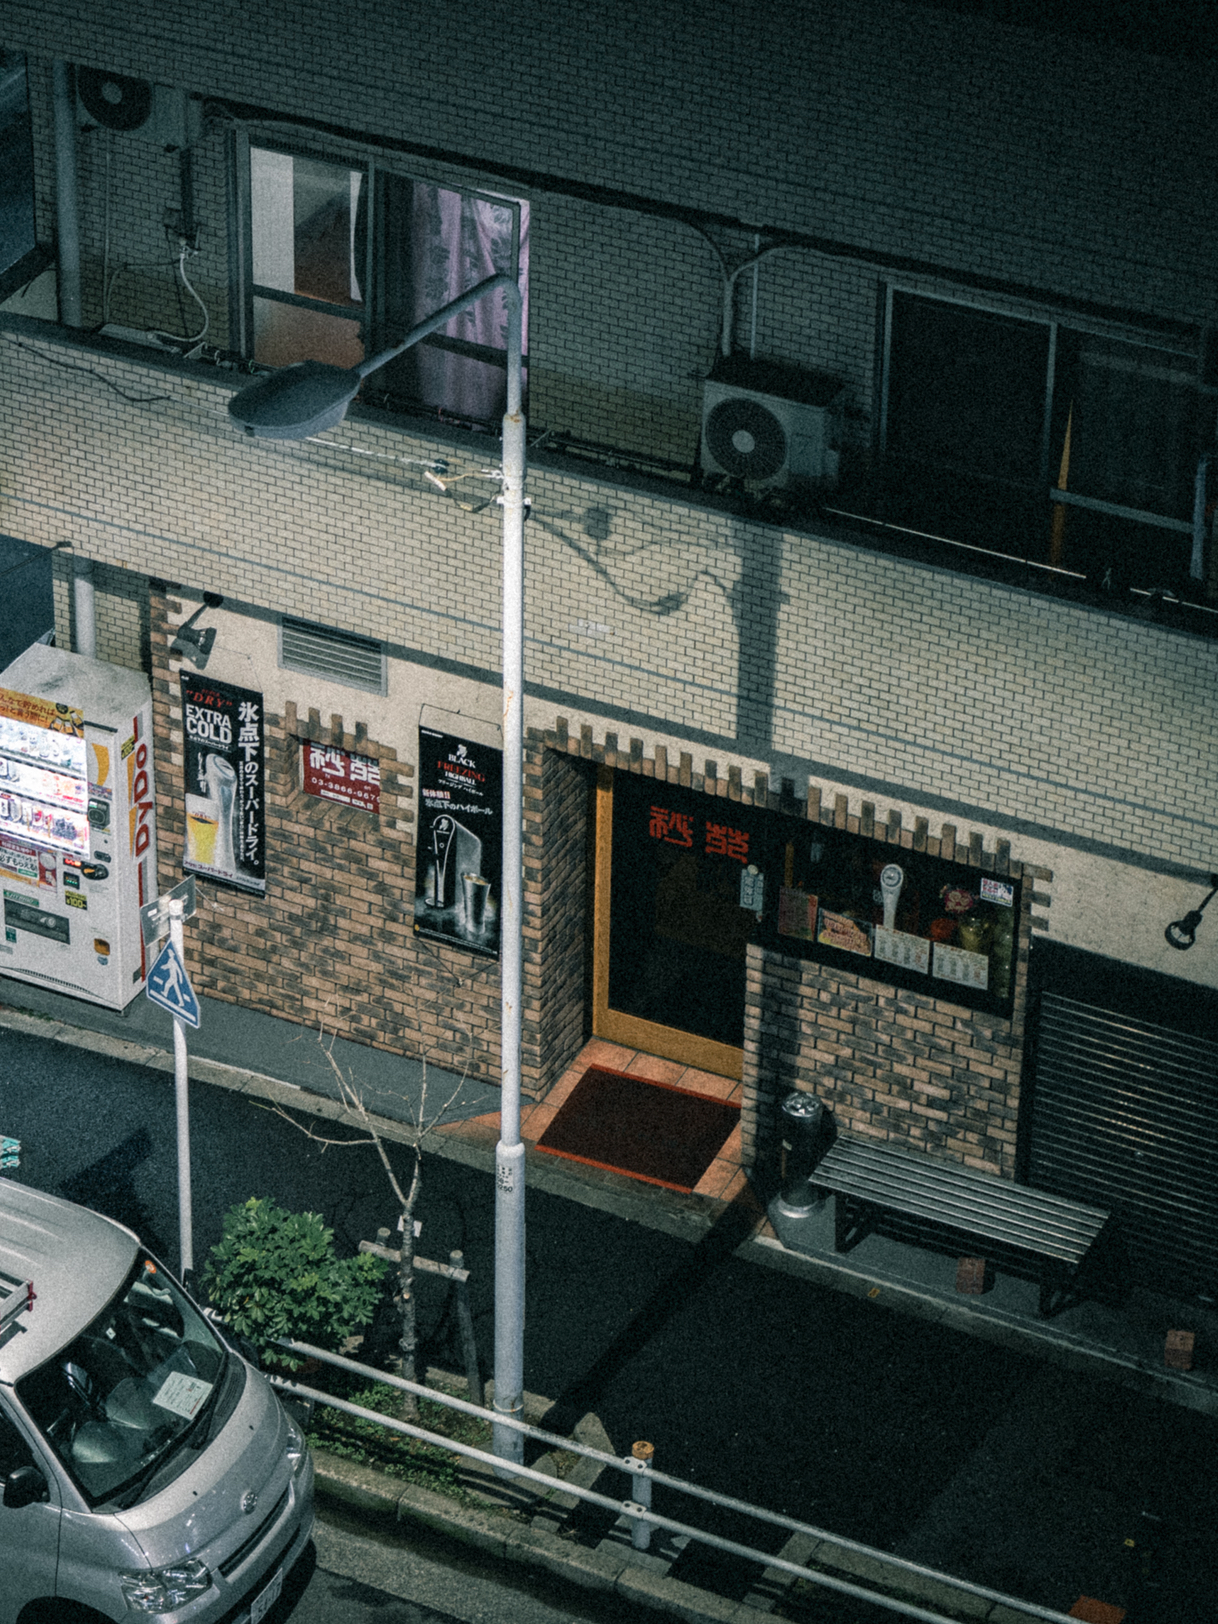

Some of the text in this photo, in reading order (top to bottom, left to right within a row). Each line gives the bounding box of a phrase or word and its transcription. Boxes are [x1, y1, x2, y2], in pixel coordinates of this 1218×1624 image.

[185, 703, 232, 730] EXTRA
[186, 716, 232, 744] COLD
[437, 760, 486, 782] FREEZING
[448, 753, 477, 769] BLACK
[238, 701, 261, 866] 氷点下のスーパードライ。
[444, 770, 477, 786] HIGHBALL
[425, 798, 493, 816] 氷点下のハイボール
